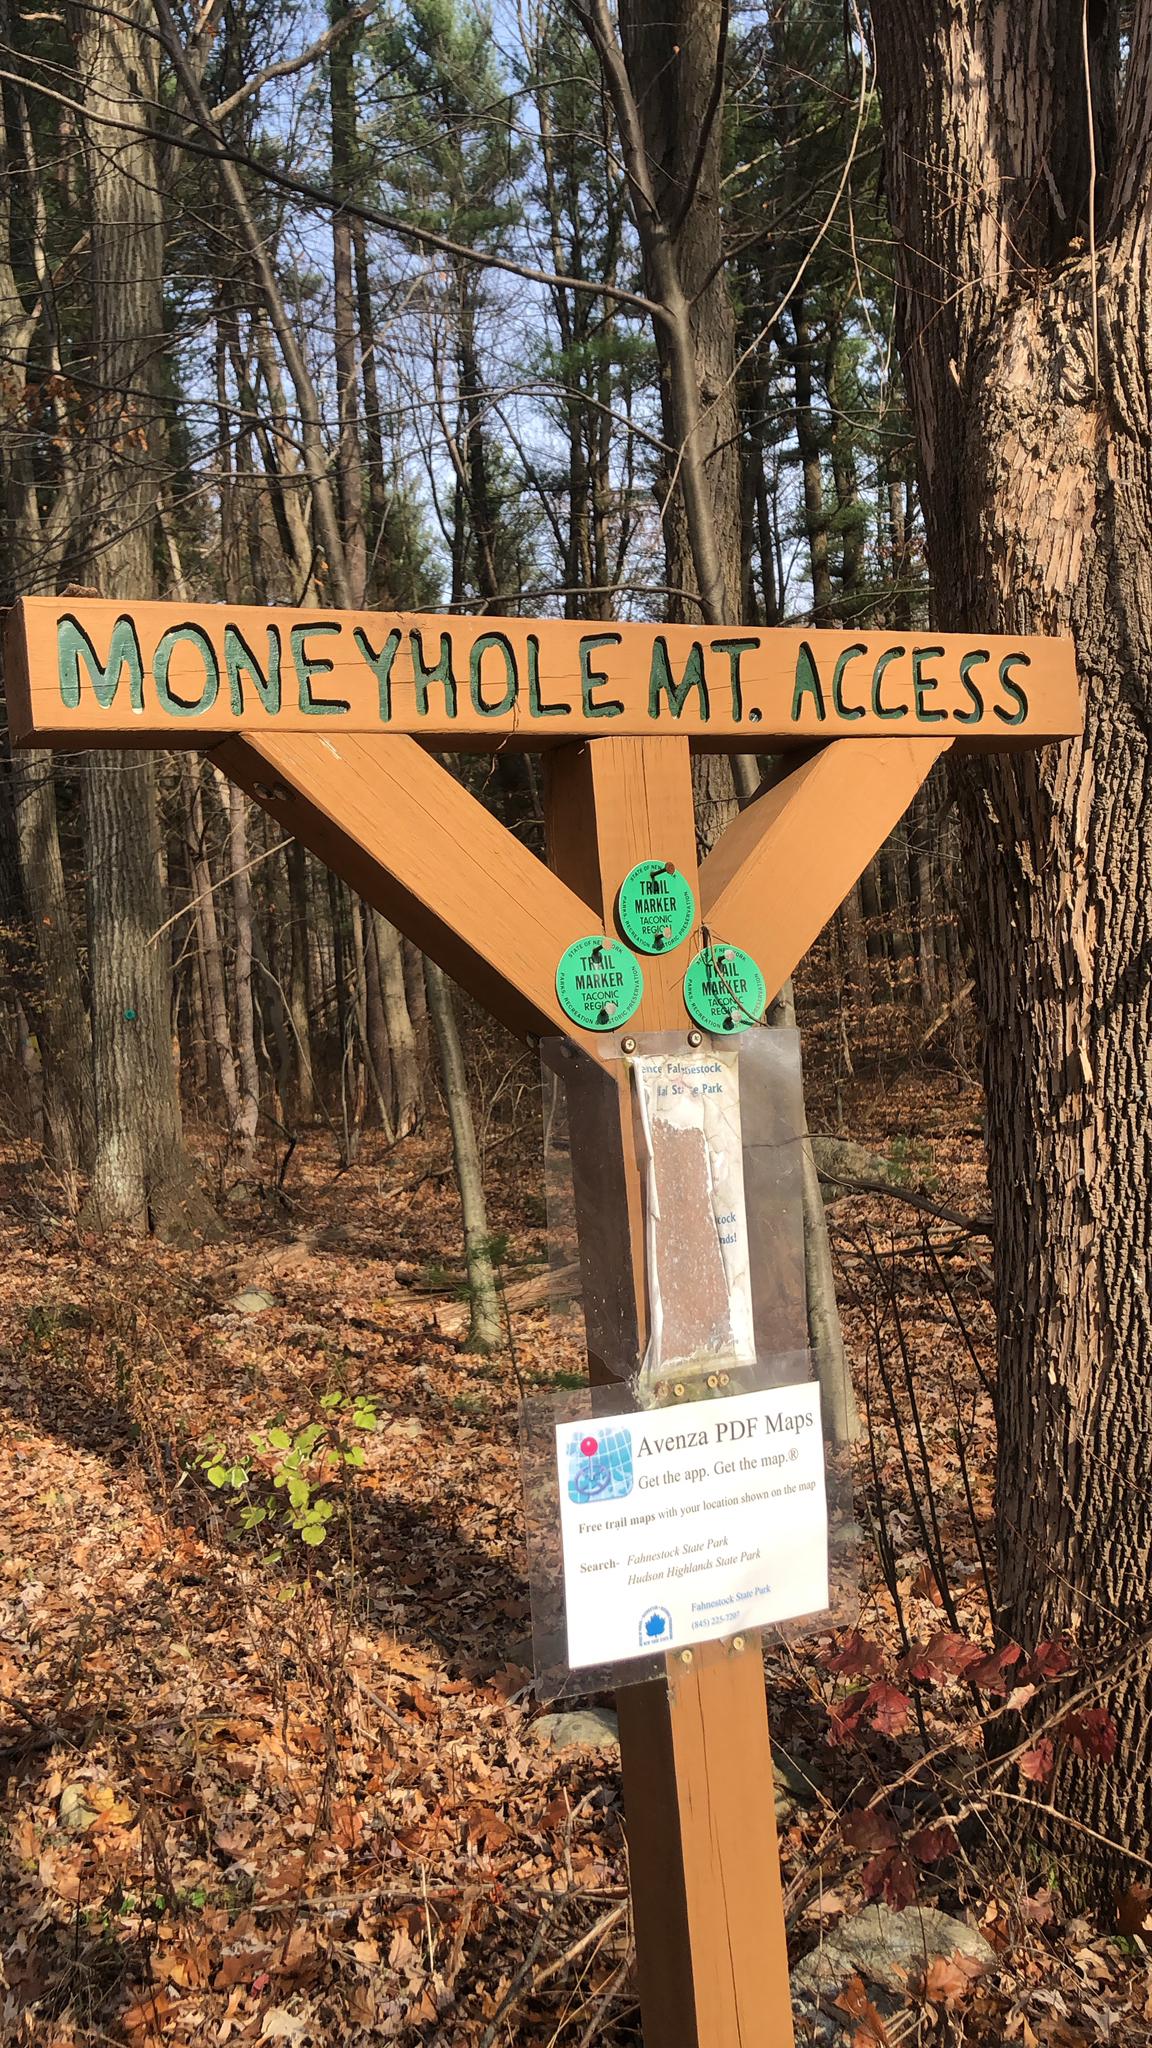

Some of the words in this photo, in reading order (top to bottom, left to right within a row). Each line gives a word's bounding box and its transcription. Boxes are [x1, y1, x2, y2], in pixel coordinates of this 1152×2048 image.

[57, 613, 624, 722] MONEYHOLE
[648, 635, 763, 723] MT.
[791, 641, 1031, 726] ACCESS
[640, 880, 670, 895] TRAIL
[635, 897, 676, 914] MARKER
[640, 914, 672, 924] TACONIC
[580, 955, 615, 972] TRAIL
[575, 972, 624, 990] MARKER
[581, 990, 620, 1002] TACONIC
[564, 997, 594, 1024] RECREATION
[702, 1082, 723, 1094] Park
[637, 1430, 708, 1458] Avenza
[715, 1417, 758, 1444] PDF
[765, 1411, 814, 1435] Maps
[638, 1475, 660, 1490] Get
[663, 1470, 681, 1485] the
[684, 1467, 710, 1483] app.
[714, 1460, 736, 1475] Get
[740, 1456, 758, 1470] the
[578, 1523, 603, 1534] Free
[606, 1517, 627, 1530] trail
[630, 1513, 656, 1526] maps
[658, 1506, 678, 1520] with
[680, 1503, 701, 1518] your
[702, 1496, 739, 1511] location
[740, 1490, 769, 1504] shown
[771, 1488, 782, 1498] on
[784, 1484, 797, 1495] the
[798, 1480, 816, 1492] map
[580, 1558, 620, 1574] Search-
[627, 1546, 680, 1566] Fahnestock
[682, 1542, 704, 1556] State
[707, 1536, 729, 1550] Park
[628, 1568, 664, 1586] Hudson
[666, 1559, 714, 1578] Highlands
[715, 1554, 738, 1568] State
[740, 1548, 761, 1563] Park
[692, 1594, 734, 1612] Fahnestock
[736, 1588, 754, 1602] State
[754, 1584, 771, 1596] Park
[692, 1616, 710, 1630] (845)
